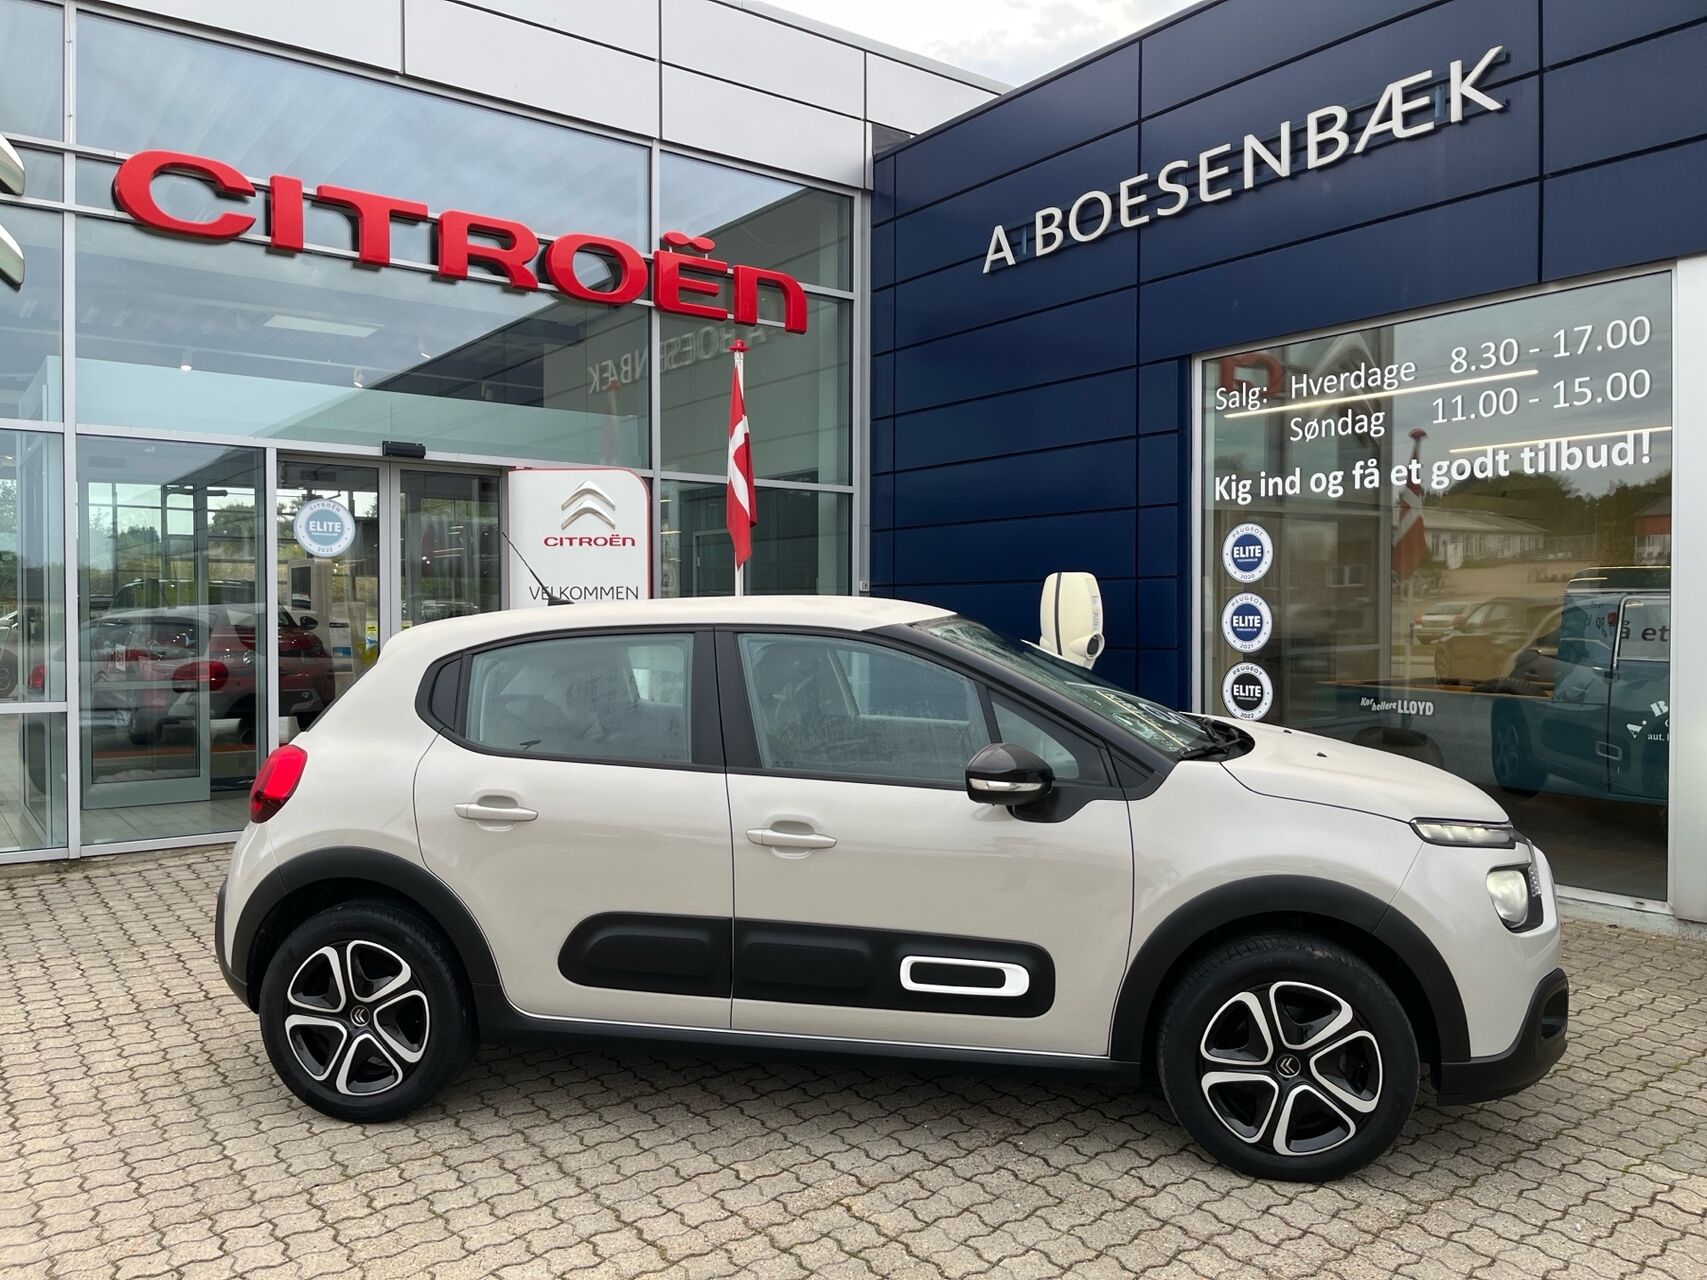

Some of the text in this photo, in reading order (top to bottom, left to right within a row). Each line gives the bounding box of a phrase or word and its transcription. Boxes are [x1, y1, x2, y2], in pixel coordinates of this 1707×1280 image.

[982, 45, 1505, 274] A BOESENBÆK
[115, 149, 807, 335] CITROËN
[1215, 382, 1268, 411] Salg:
[1290, 361, 1416, 400] Hverdage
[1449, 338, 1519, 375] 8.30
[1553, 315, 1651, 358] 17.00
[1289, 408, 1386, 443] Søndag
[1432, 387, 1519, 425] 11.00
[1553, 368, 1651, 409] 15.00
[1214, 430, 1651, 506] Kig ind og få et godt tilbud!
[309, 520, 341, 532] ELITE
[1231, 526, 1264, 538] PEUGEOT
[543, 533, 637, 548] CITROËN
[1233, 545, 1262, 558] ELITE
[528, 586, 640, 601] VELKOMMEN
[1231, 595, 1264, 607] PEUGEOT
[1232, 615, 1261, 628] ELITE
[1232, 665, 1264, 676] PEUGEOT
[1233, 684, 1262, 697] ELITE
[1371, 700, 1397, 711] hellere
[1397, 699, 1435, 716] LLOYD
